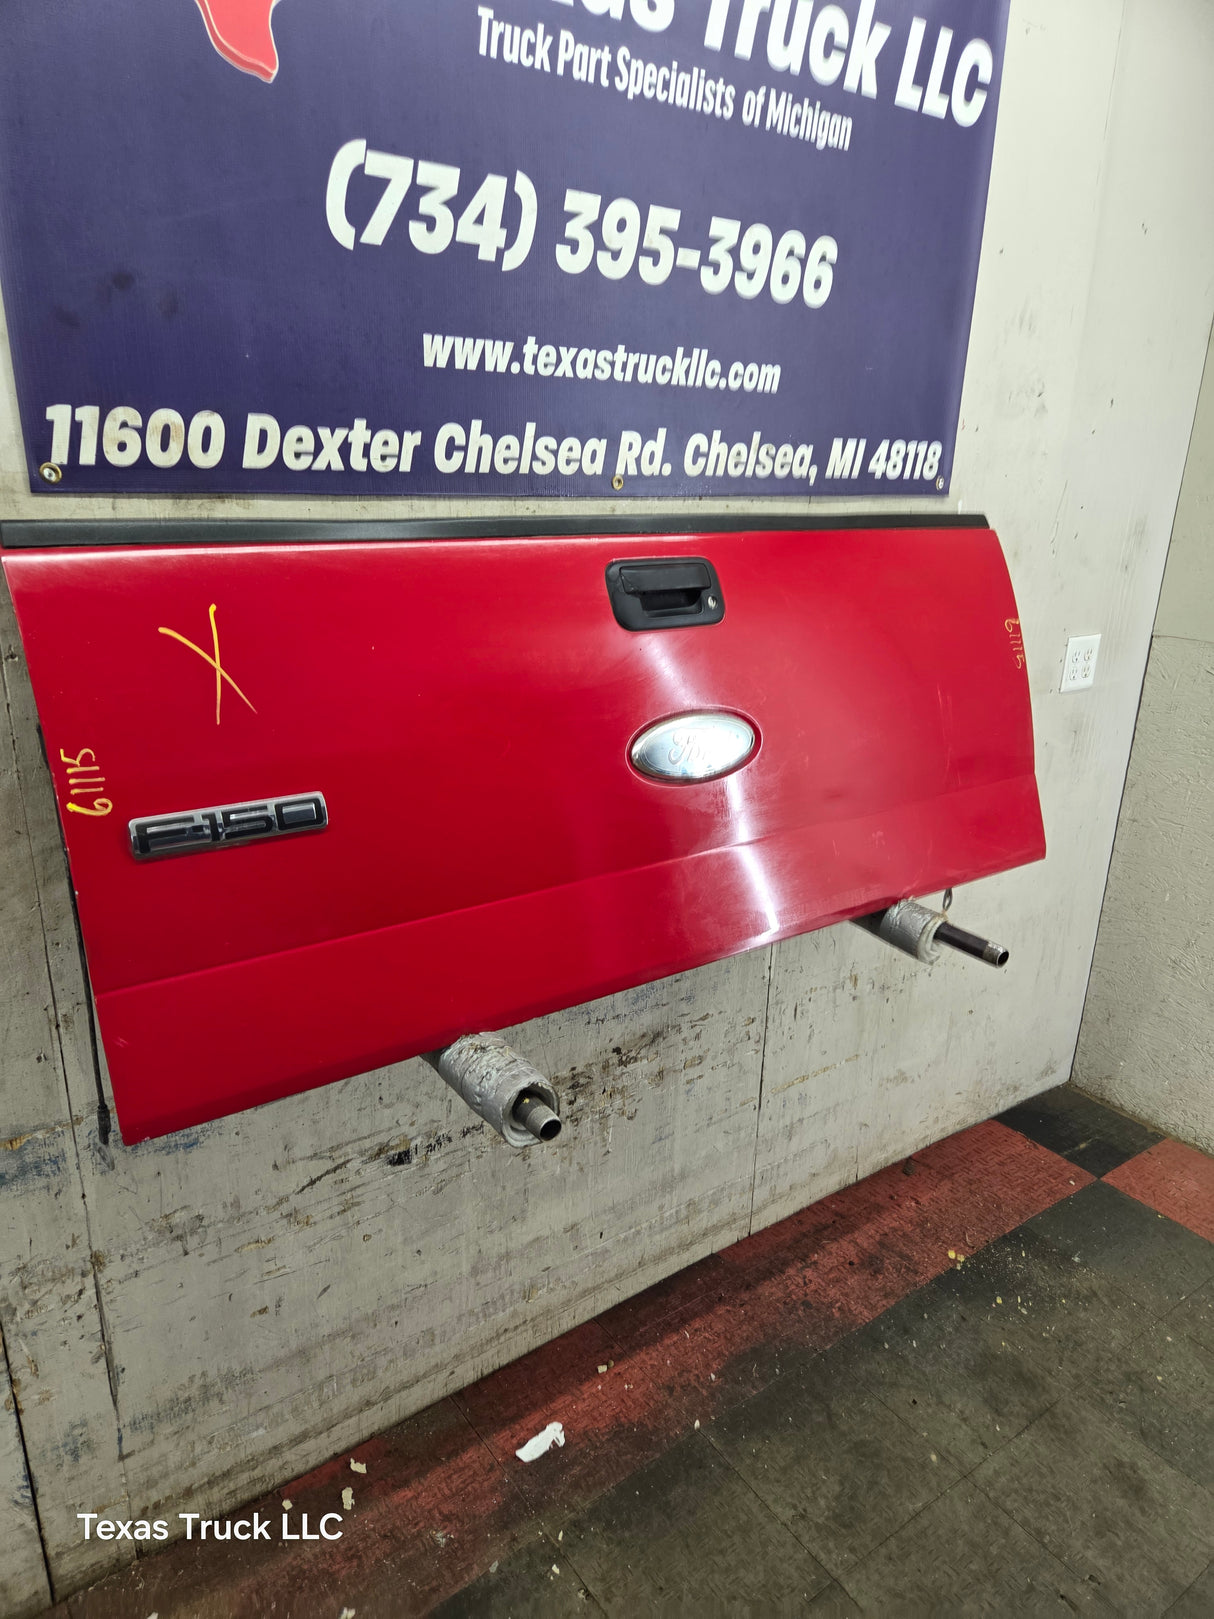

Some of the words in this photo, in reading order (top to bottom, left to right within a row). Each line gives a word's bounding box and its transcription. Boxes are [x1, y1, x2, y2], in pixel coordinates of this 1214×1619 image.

[477, 5, 553, 72] Truck
[556, 28, 612, 88] Part
[614, 45, 736, 121] Specialists
[741, 85, 767, 129] of
[765, 87, 853, 152] Michigan
[894, 15, 993, 128] LLC
[325, 138, 538, 272] (734)
[555, 188, 839, 309] 395-3966
[422, 332, 782, 394] www.texastruckllc.com
[45, 403, 226, 469] 11600
[242, 412, 422, 473] Dexter
[433, 419, 607, 475] Chelsea
[615, 428, 672, 476] Rd.
[683, 429, 818, 486] Chelsea,
[825, 437, 866, 480] MI
[867, 439, 942, 482] 48118
[60, 747, 113, 816] 61115
